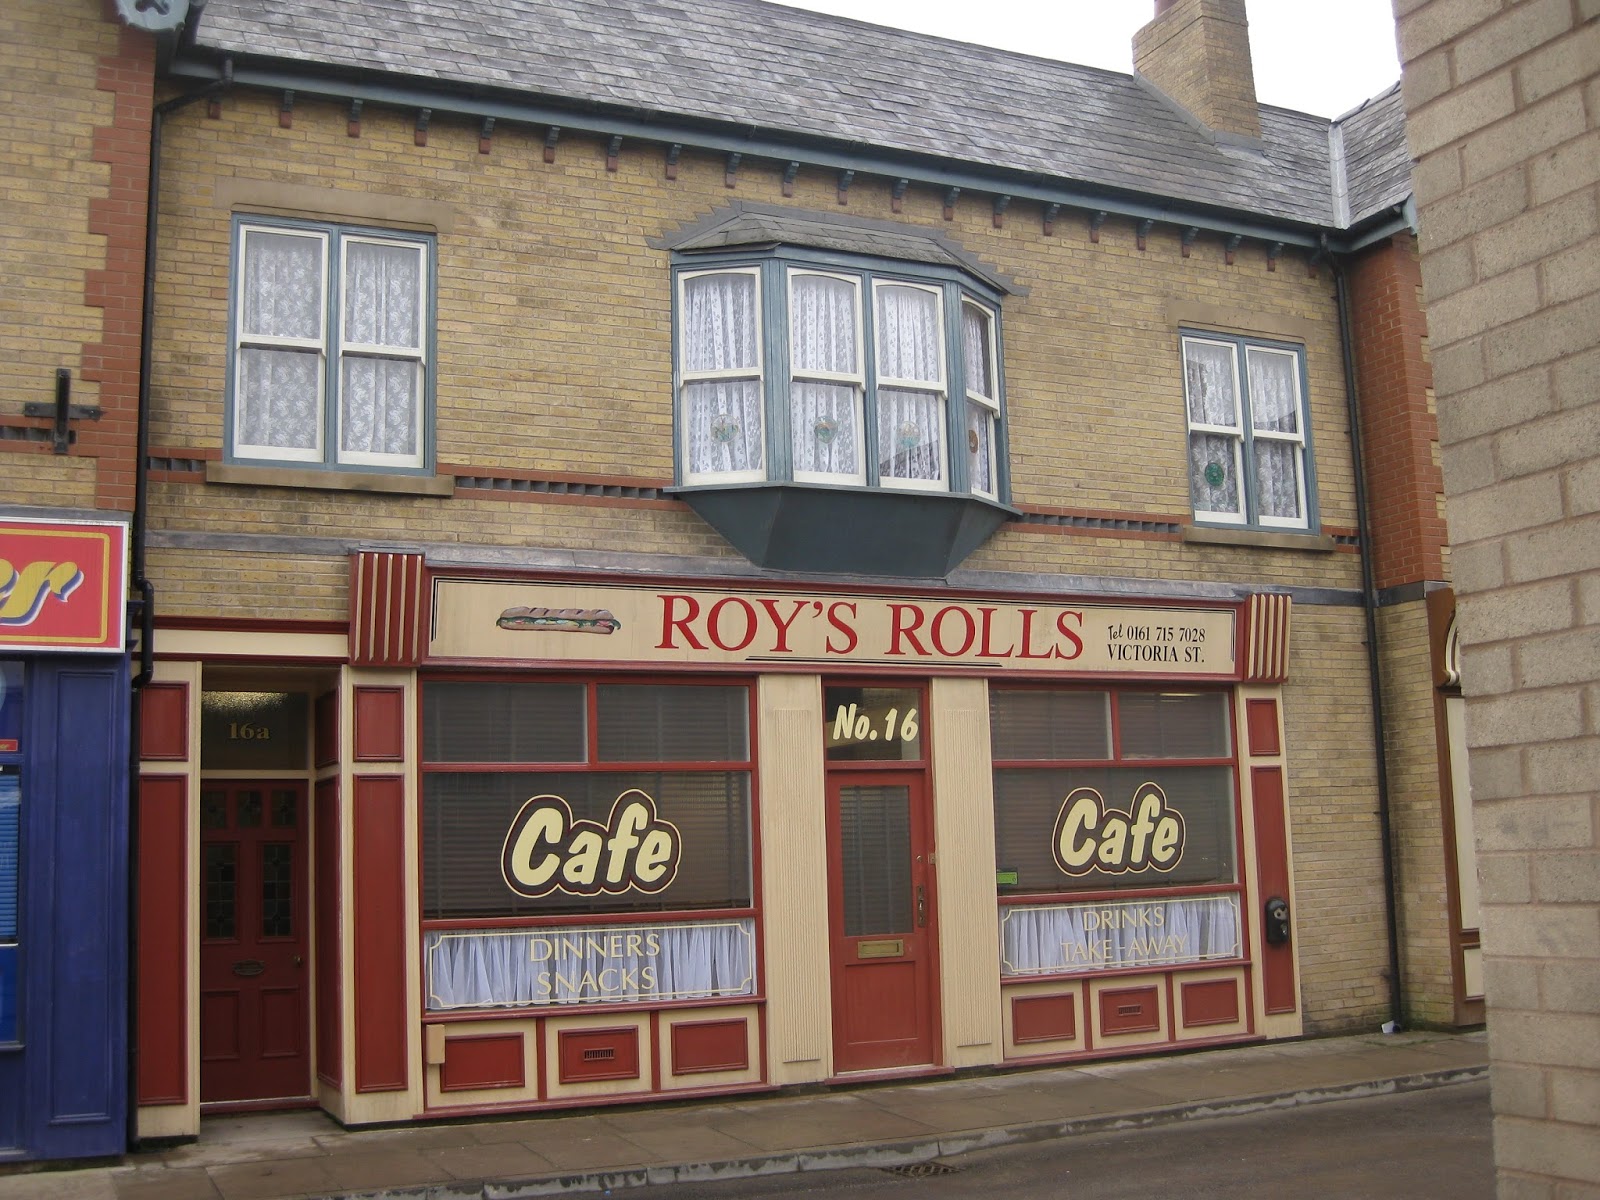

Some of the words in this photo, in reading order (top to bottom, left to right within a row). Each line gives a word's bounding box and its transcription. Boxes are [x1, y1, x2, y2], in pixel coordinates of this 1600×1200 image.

[654, 594, 858, 655] ROY'S
[884, 603, 1084, 660] ROLLS
[1108, 623, 1123, 640] Tel
[1127, 625, 1150, 641] 0161
[1156, 626, 1174, 642] 715
[1179, 627, 1206, 643] 7028
[1107, 643, 1178, 662] VICTORIA
[1184, 646, 1205, 663] ST.
[228, 723, 270, 740] 16a
[833, 703, 878, 741] No.
[885, 708, 919, 742] 16
[511, 801, 672, 886] Cafe
[1059, 793, 1179, 867] Cafe
[1083, 906, 1165, 931] DRINKS
[530, 933, 660, 962] DINNERS
[537, 966, 657, 995] SNACKS
